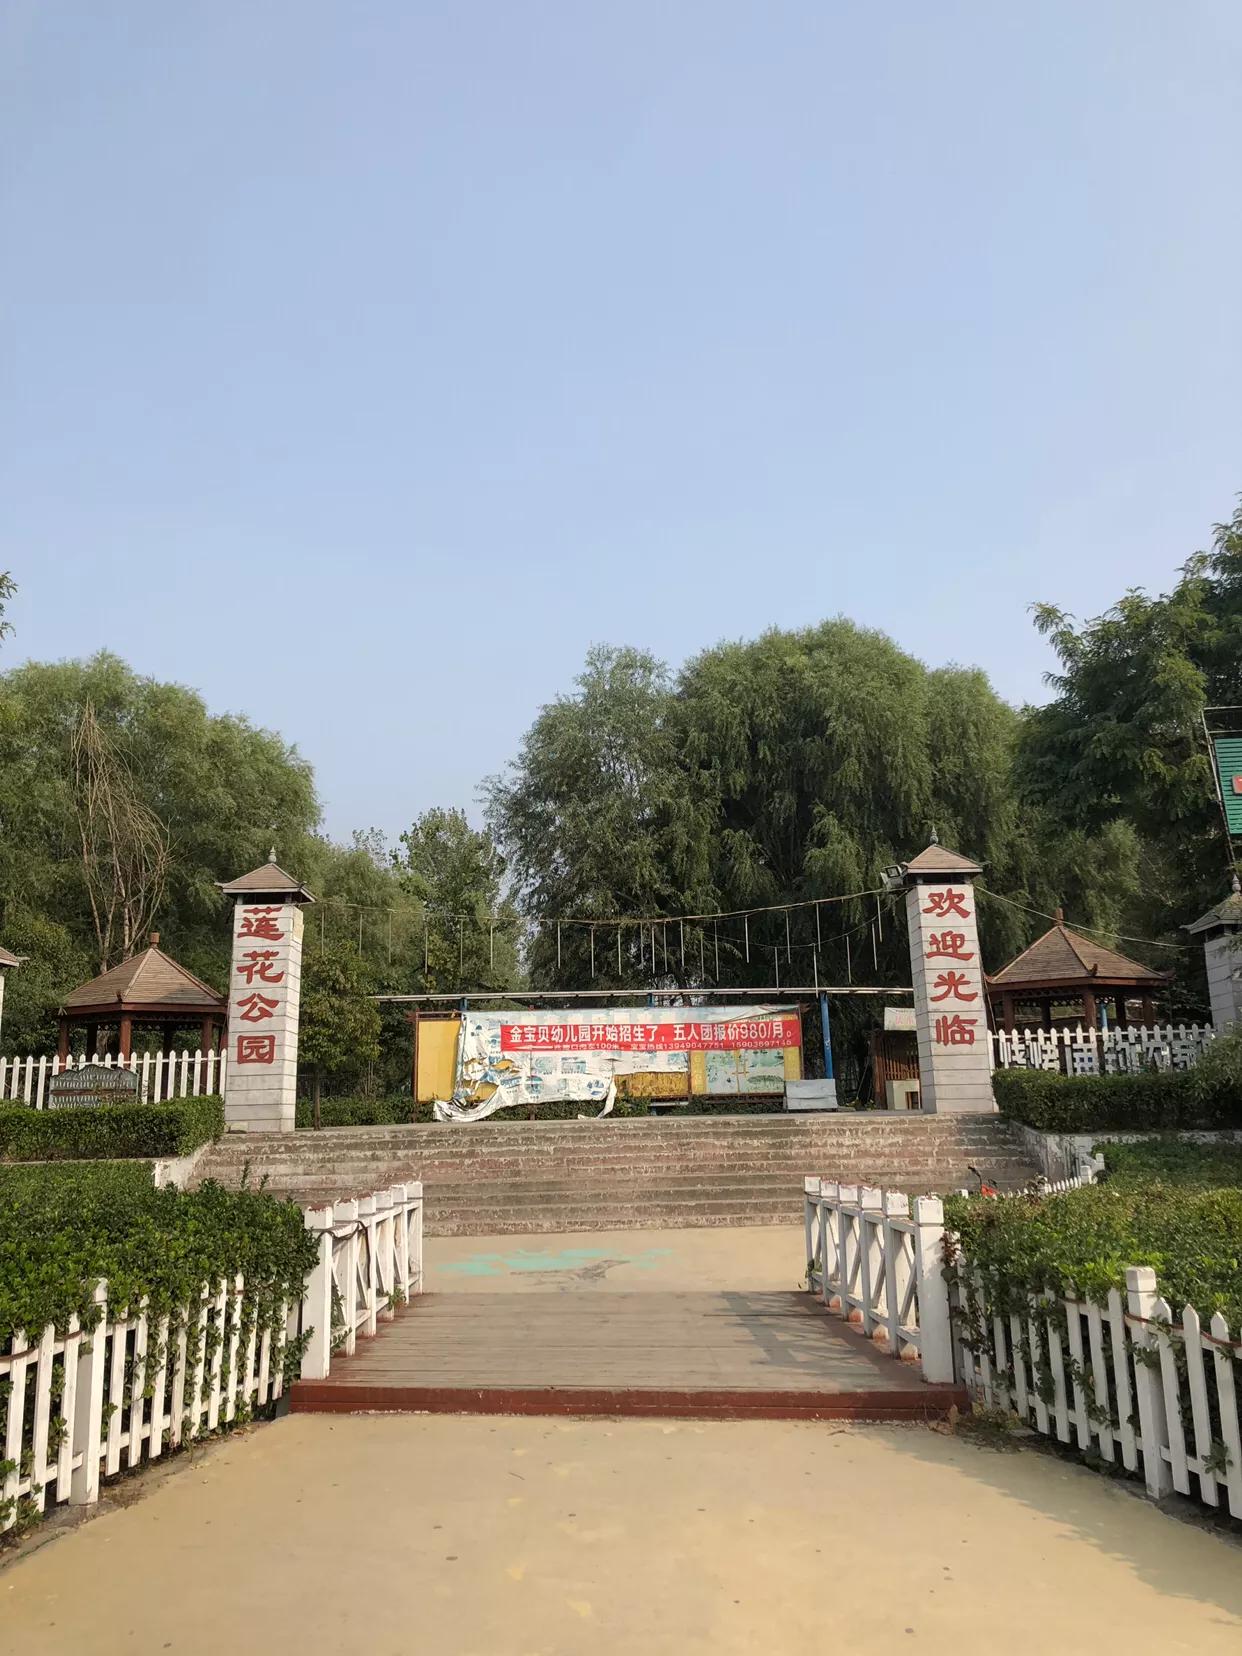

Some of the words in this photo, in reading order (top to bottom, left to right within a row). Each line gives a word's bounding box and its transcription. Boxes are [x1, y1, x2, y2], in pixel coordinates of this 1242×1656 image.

[237, 906, 285, 1065] 莲花公园
[922, 887, 979, 1046] 欢迎光临
